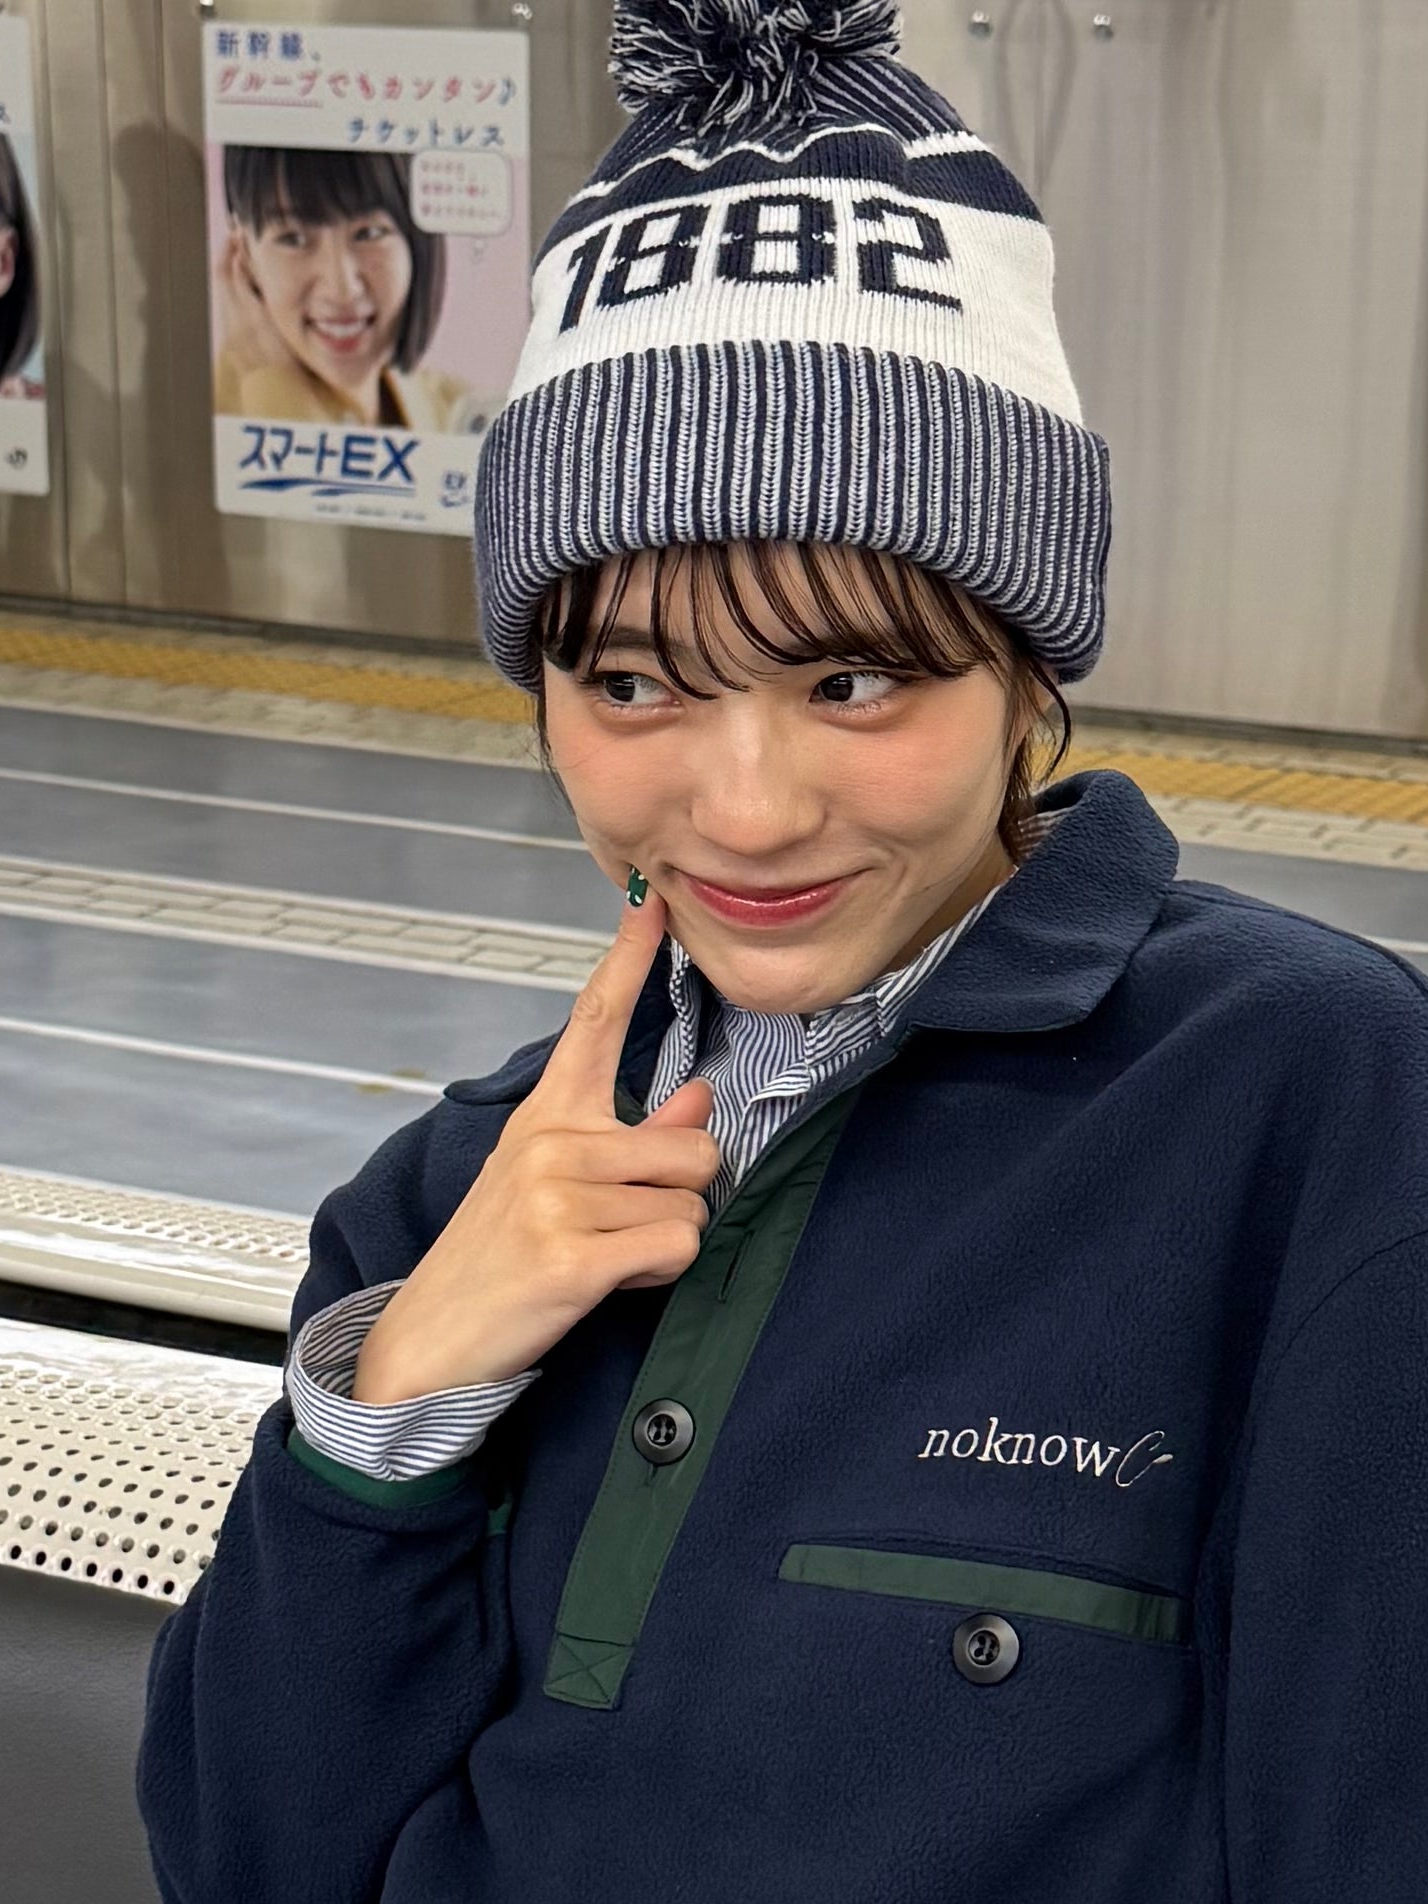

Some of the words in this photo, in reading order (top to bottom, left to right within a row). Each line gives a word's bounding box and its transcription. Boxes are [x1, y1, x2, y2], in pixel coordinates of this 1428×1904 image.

[558, 192, 964, 336] 1882
[238, 424, 421, 483] スマートEX
